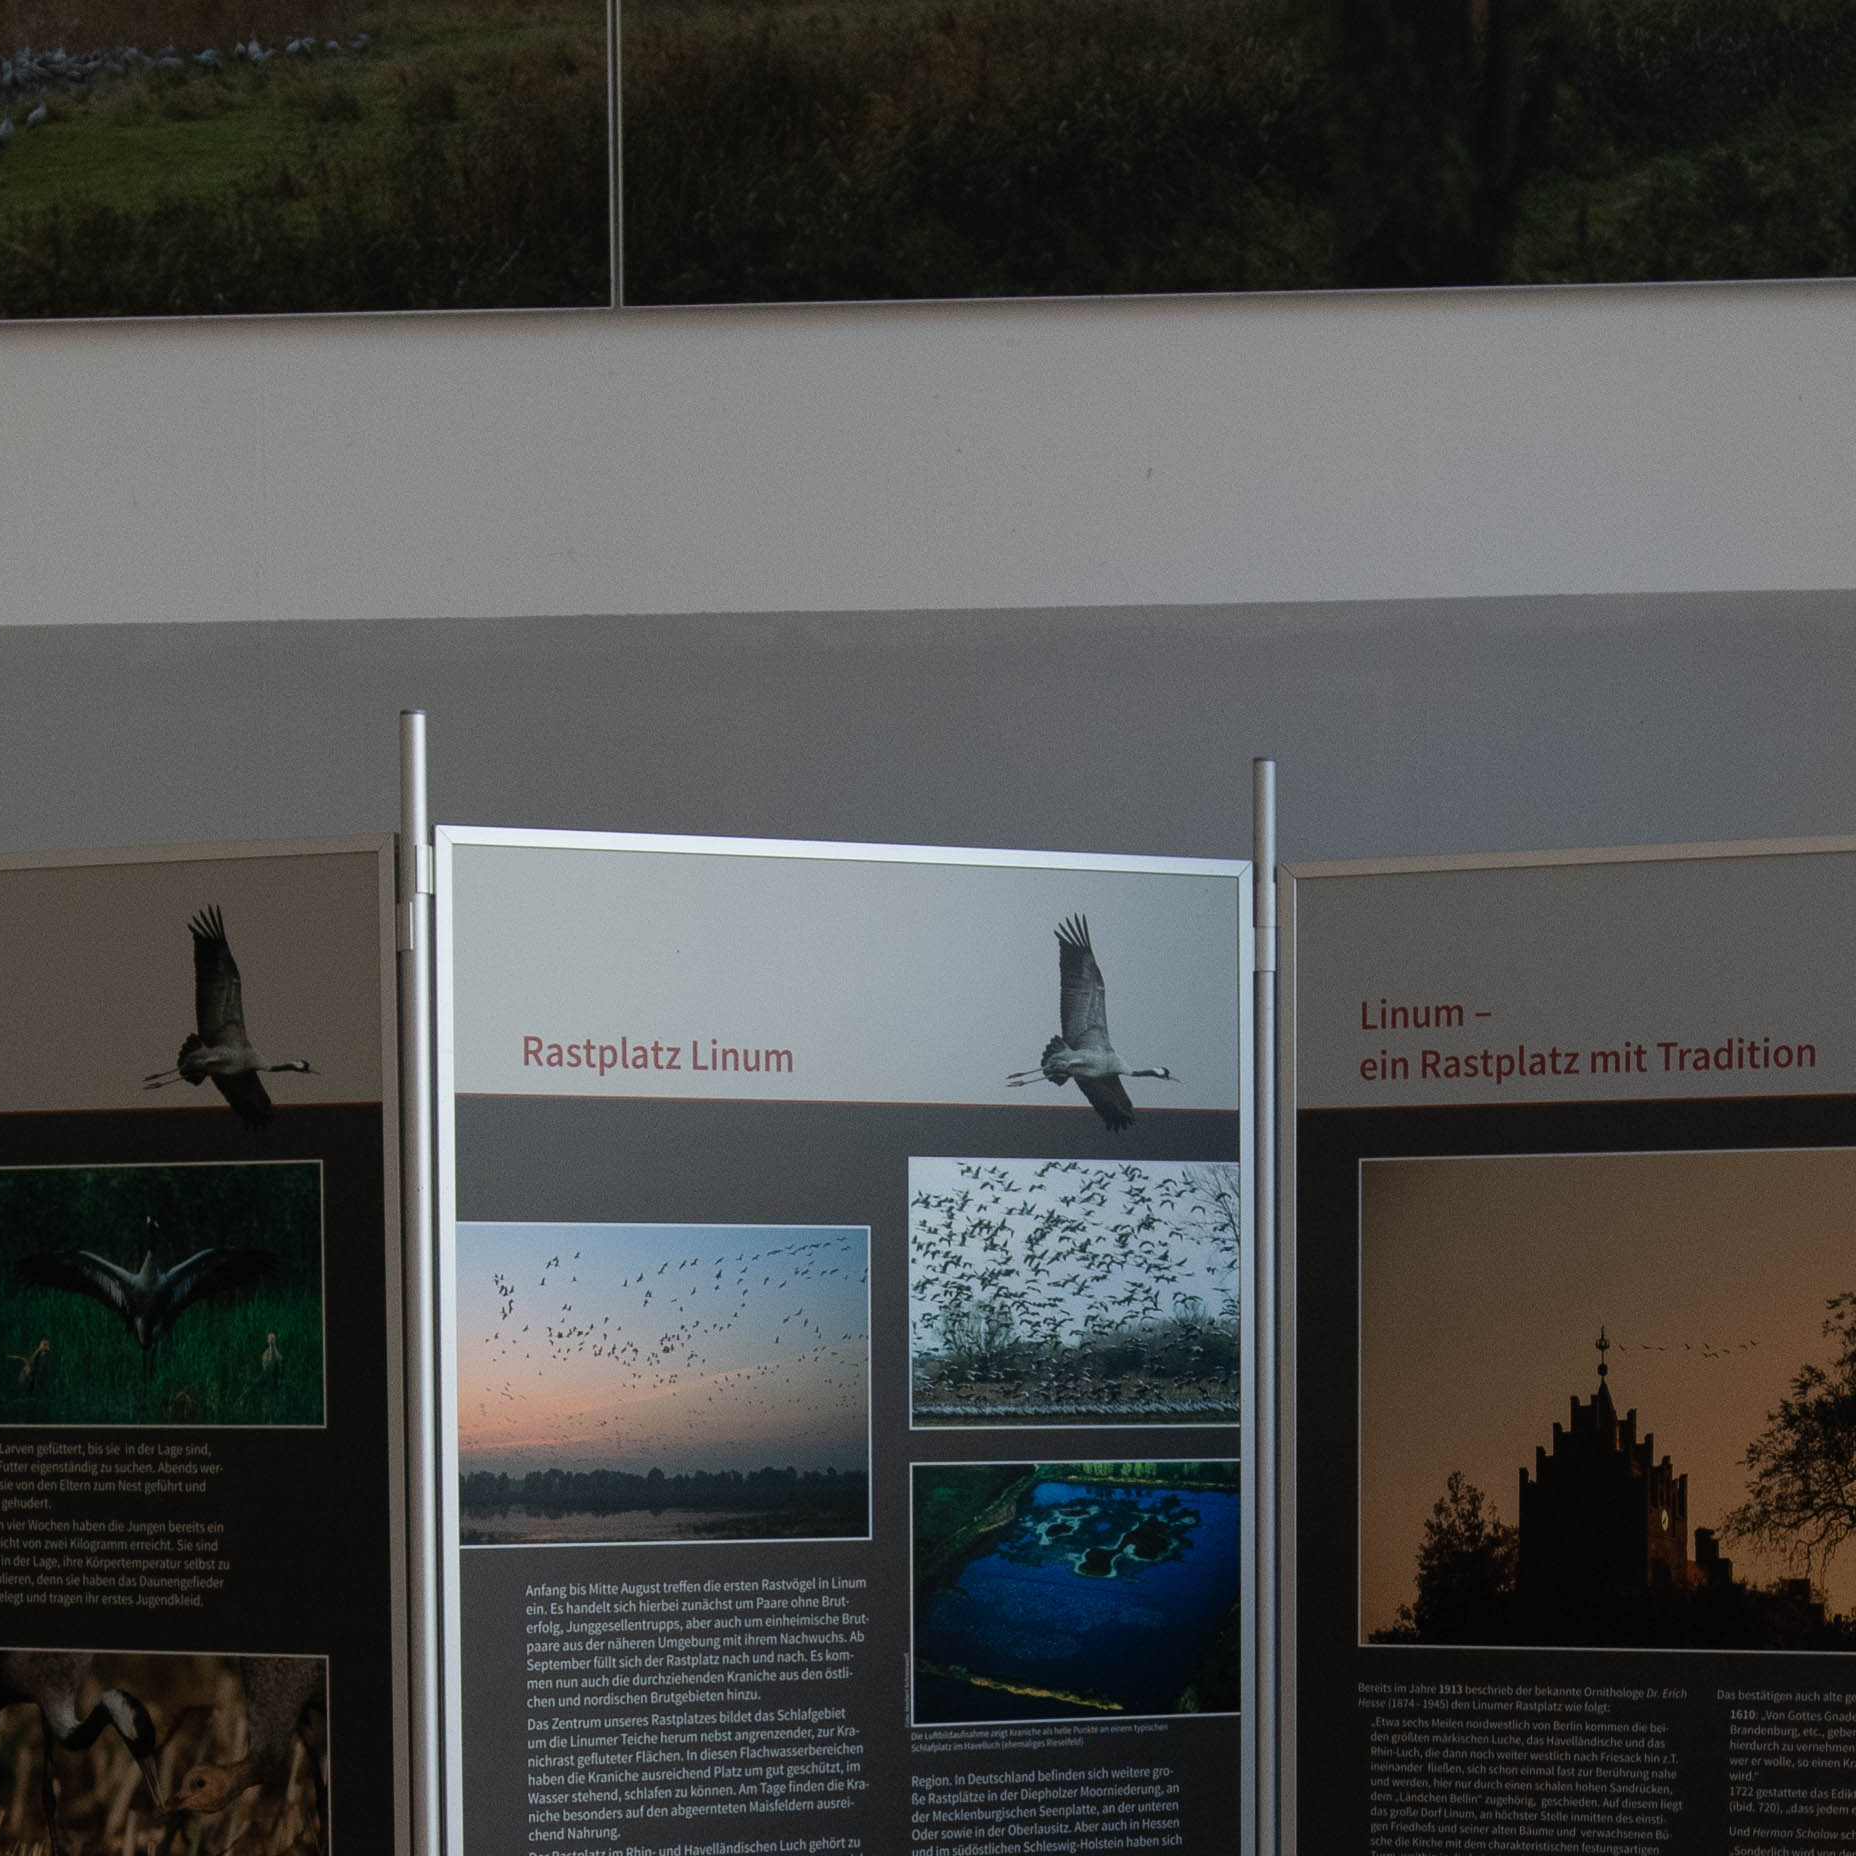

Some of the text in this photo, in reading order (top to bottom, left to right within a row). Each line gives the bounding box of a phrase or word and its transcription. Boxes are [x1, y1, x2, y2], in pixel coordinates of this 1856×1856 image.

[1360, 998, 1463, 1030] Linum
[523, 1035, 793, 1076] Rastplatz Linum
[1359, 1036, 1816, 1084] ein Rastplatz mit Tradition
[524, 1577, 866, 1599] Anfang bis Mitte August treffen die ersten Rastvögel in Linum
